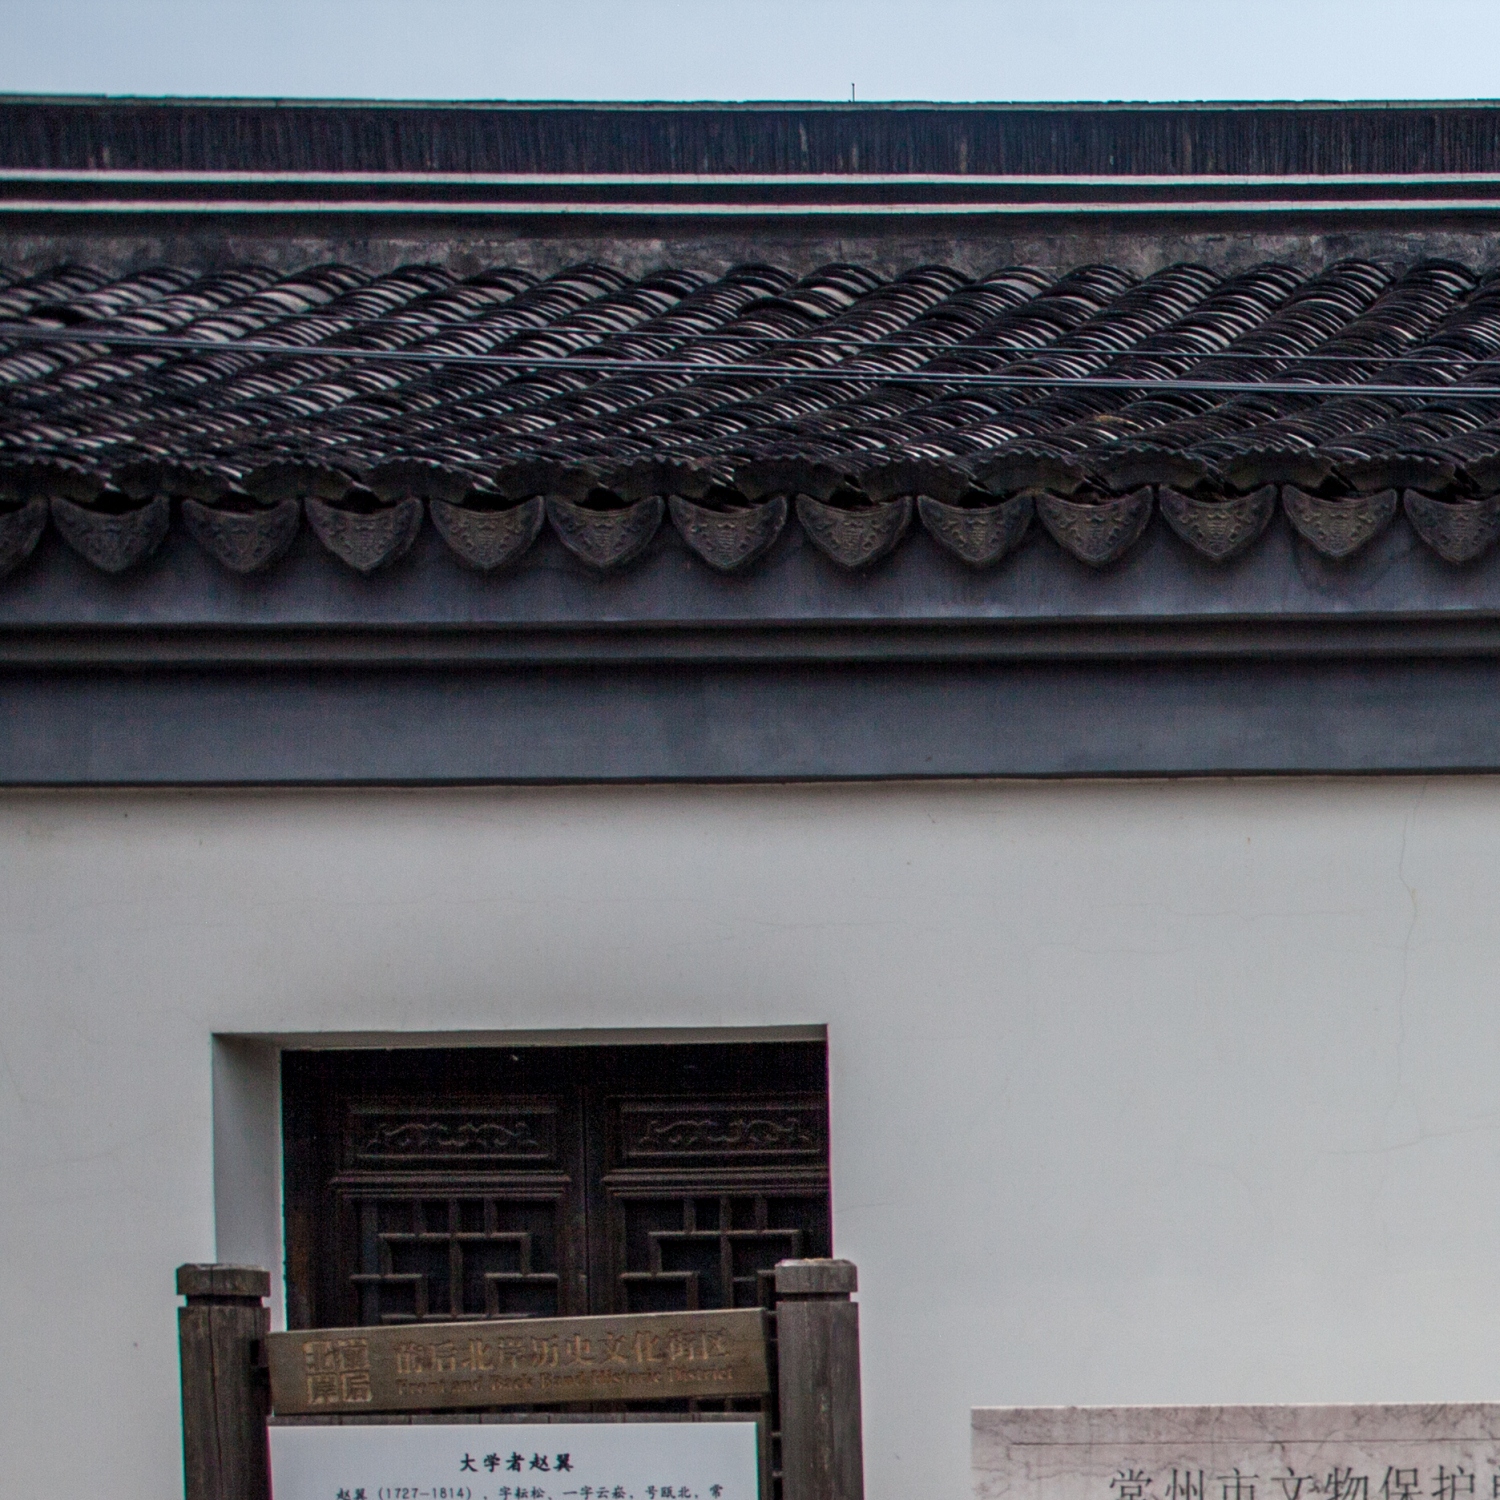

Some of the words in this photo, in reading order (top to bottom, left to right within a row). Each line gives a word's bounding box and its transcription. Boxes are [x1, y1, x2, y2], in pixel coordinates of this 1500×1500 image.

[459, 1451, 574, 1472] 大学者赵翼
